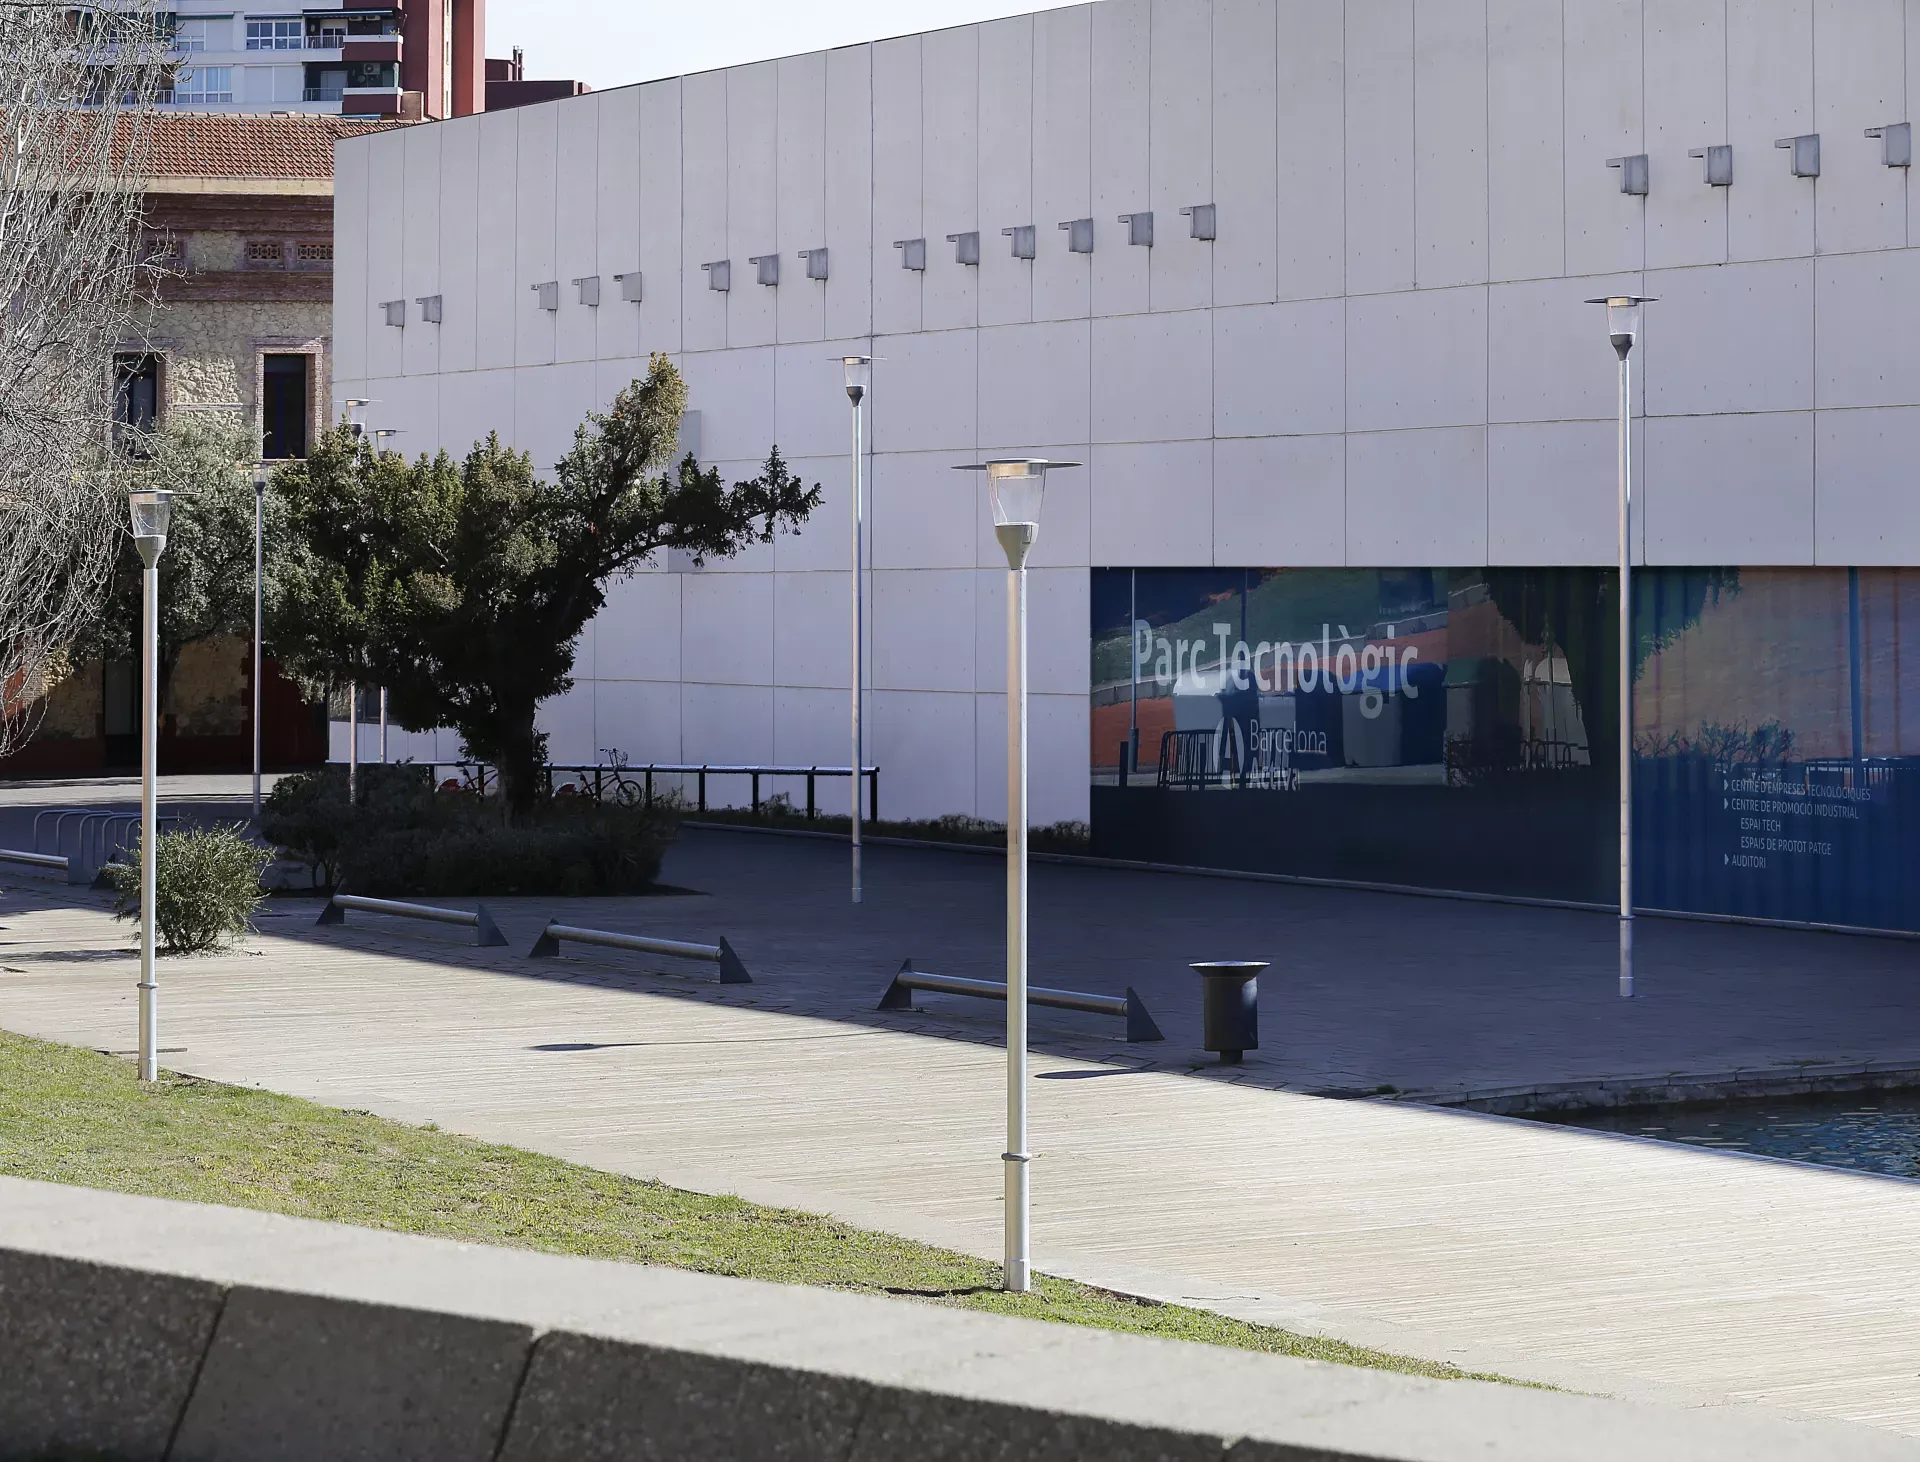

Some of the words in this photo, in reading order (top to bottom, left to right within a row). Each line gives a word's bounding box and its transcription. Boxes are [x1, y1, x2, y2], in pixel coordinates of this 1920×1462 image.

[1134, 619, 1206, 688] Parc
[1212, 622, 1419, 719] Tecnològic
[1250, 719, 1327, 755] Barcelona
[1249, 756, 1300, 791] Activa
[1731, 779, 1759, 793] CENTRE
[1760, 781, 1806, 796] D'EMPRESES
[1731, 798, 1759, 812] CENTRE
[1760, 800, 1771, 812] DE
[1772, 801, 1813, 816] PROMOCIÓ
[1814, 804, 1860, 819] INDUSTRIAL
[1740, 817, 1761, 831] ESPAI
[1762, 819, 1781, 832] TECH
[1740, 836, 1765, 850] ESPAIS
[1766, 838, 1776, 851] DE
[1731, 854, 1767, 869] AUDITORI
